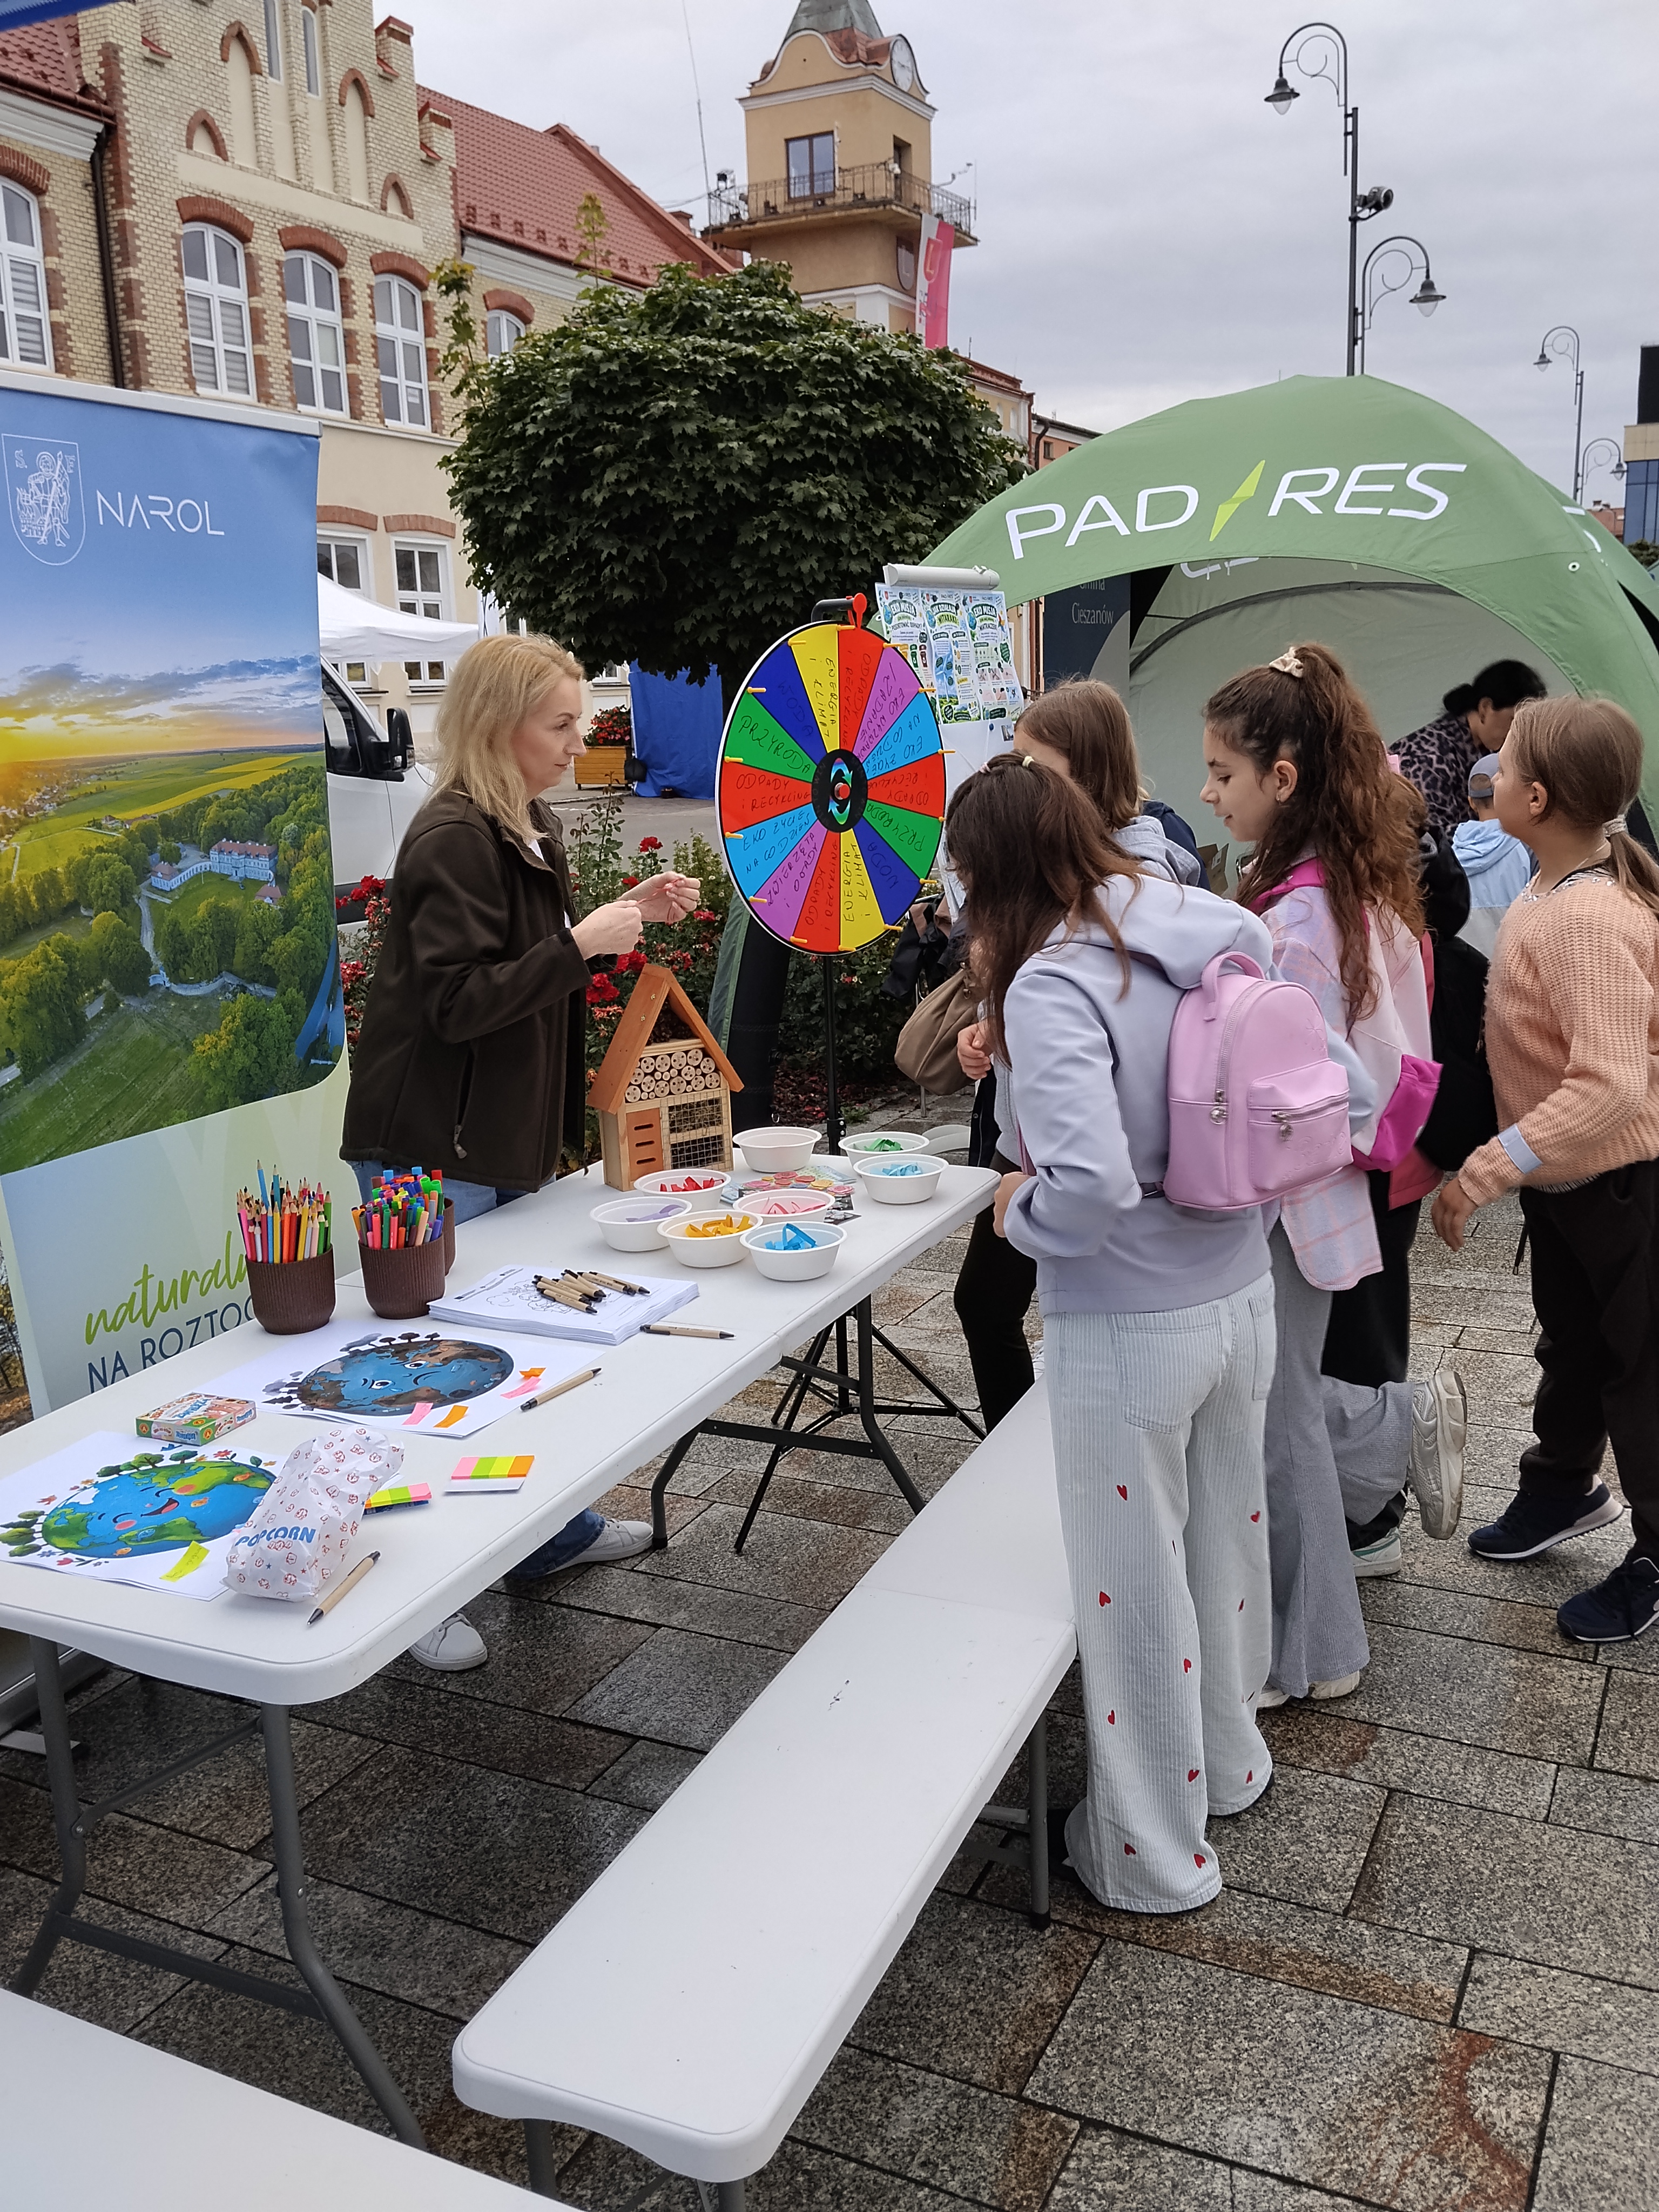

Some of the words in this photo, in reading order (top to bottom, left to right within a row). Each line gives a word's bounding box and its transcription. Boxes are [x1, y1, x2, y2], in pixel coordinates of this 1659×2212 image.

[96, 489, 225, 536] NAROL
[1005, 484, 1199, 559] PAD
[1267, 463, 1467, 520] RES
[891, 603, 900, 615] EKO
[900, 602, 916, 616] MISJA
[973, 606, 982, 617] EKO
[982, 605, 996, 617] MISJA
[1072, 602, 1114, 624] Cieszanów
[738, 715, 811, 774] PRZYRODA
[736, 773, 790, 790] ODPADY
[743, 828, 766, 851] EKO
[88, 1351, 130, 1393] NA
[235, 1526, 316, 1547] POPCORN
